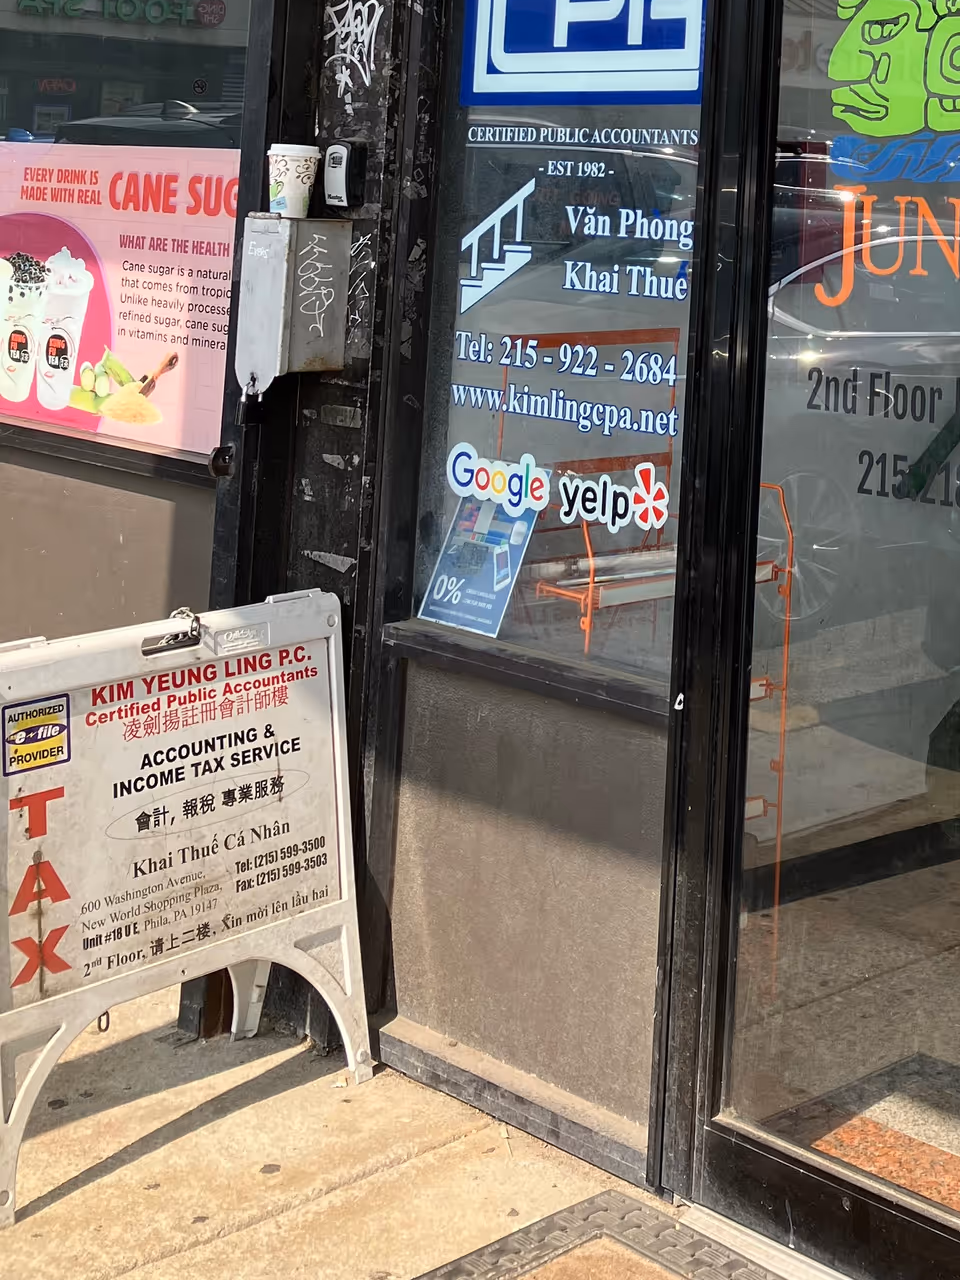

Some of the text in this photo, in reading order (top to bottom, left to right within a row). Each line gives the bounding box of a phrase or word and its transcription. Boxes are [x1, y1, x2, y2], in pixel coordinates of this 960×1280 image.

[468, 126, 698, 146] CERTIFIED PUBLIC ACCOUNTANTS
[24, 167, 99, 186] EVERY DRINK IS
[547, 160, 606, 178] EST 1982
[20, 185, 102, 205] MADE WITH REAL
[109, 172, 239, 218] CANE SUG
[119, 234, 147, 251] WHAT
[148, 236, 168, 253] ARE
[170, 237, 189, 254] THE
[191, 239, 230, 258] HEALTH
[565, 205, 695, 250] Văn Phòng
[122, 260, 232, 281] Cane sugar natural
[142, 280, 199, 295] comes from
[562, 260, 619, 295] Khai
[118, 310, 208, 331] refined sugar, cane
[120, 293, 185, 312] Unlike heavily
[128, 328, 189, 346] vitamins and
[455, 330, 678, 388] Tel: 215 922 2684
[451, 382, 679, 437] www.kimlingcpa.net
[807, 366, 858, 415] 2nd
[868, 371, 943, 423] Floor
[451, 450, 545, 508] Google
[561, 475, 630, 529] yelp
[433, 574, 466, 605] 0%
[85, 665, 318, 727] Certified Public Accountants
[91, 645, 312, 707] KIM YEUNG LING P.C.
[7, 703, 65, 724] AUTHORIZED
[9, 745, 65, 767] PROVIDER
[113, 737, 301, 799] INCOME TAX SERVICE
[140, 727, 258, 770] ACCOUNTING
[133, 820, 291, 879] Khai Thuế Cá Nhân
[235, 835, 326, 875] Tel: (215) 599-3500
[236, 852, 328, 893] Fax: (215) 599-3503
[82, 882, 223, 932] New World Shopping Plaza,
[104, 882, 164, 908] Washington
[83, 898, 218, 951] Unit #18 19147
[83, 956, 102, 978] 2nd
[107, 948, 146, 970] Floor,
[246, 904, 269, 923] mời
[271, 899, 288, 915] lên
[312, 885, 330, 902] hai
